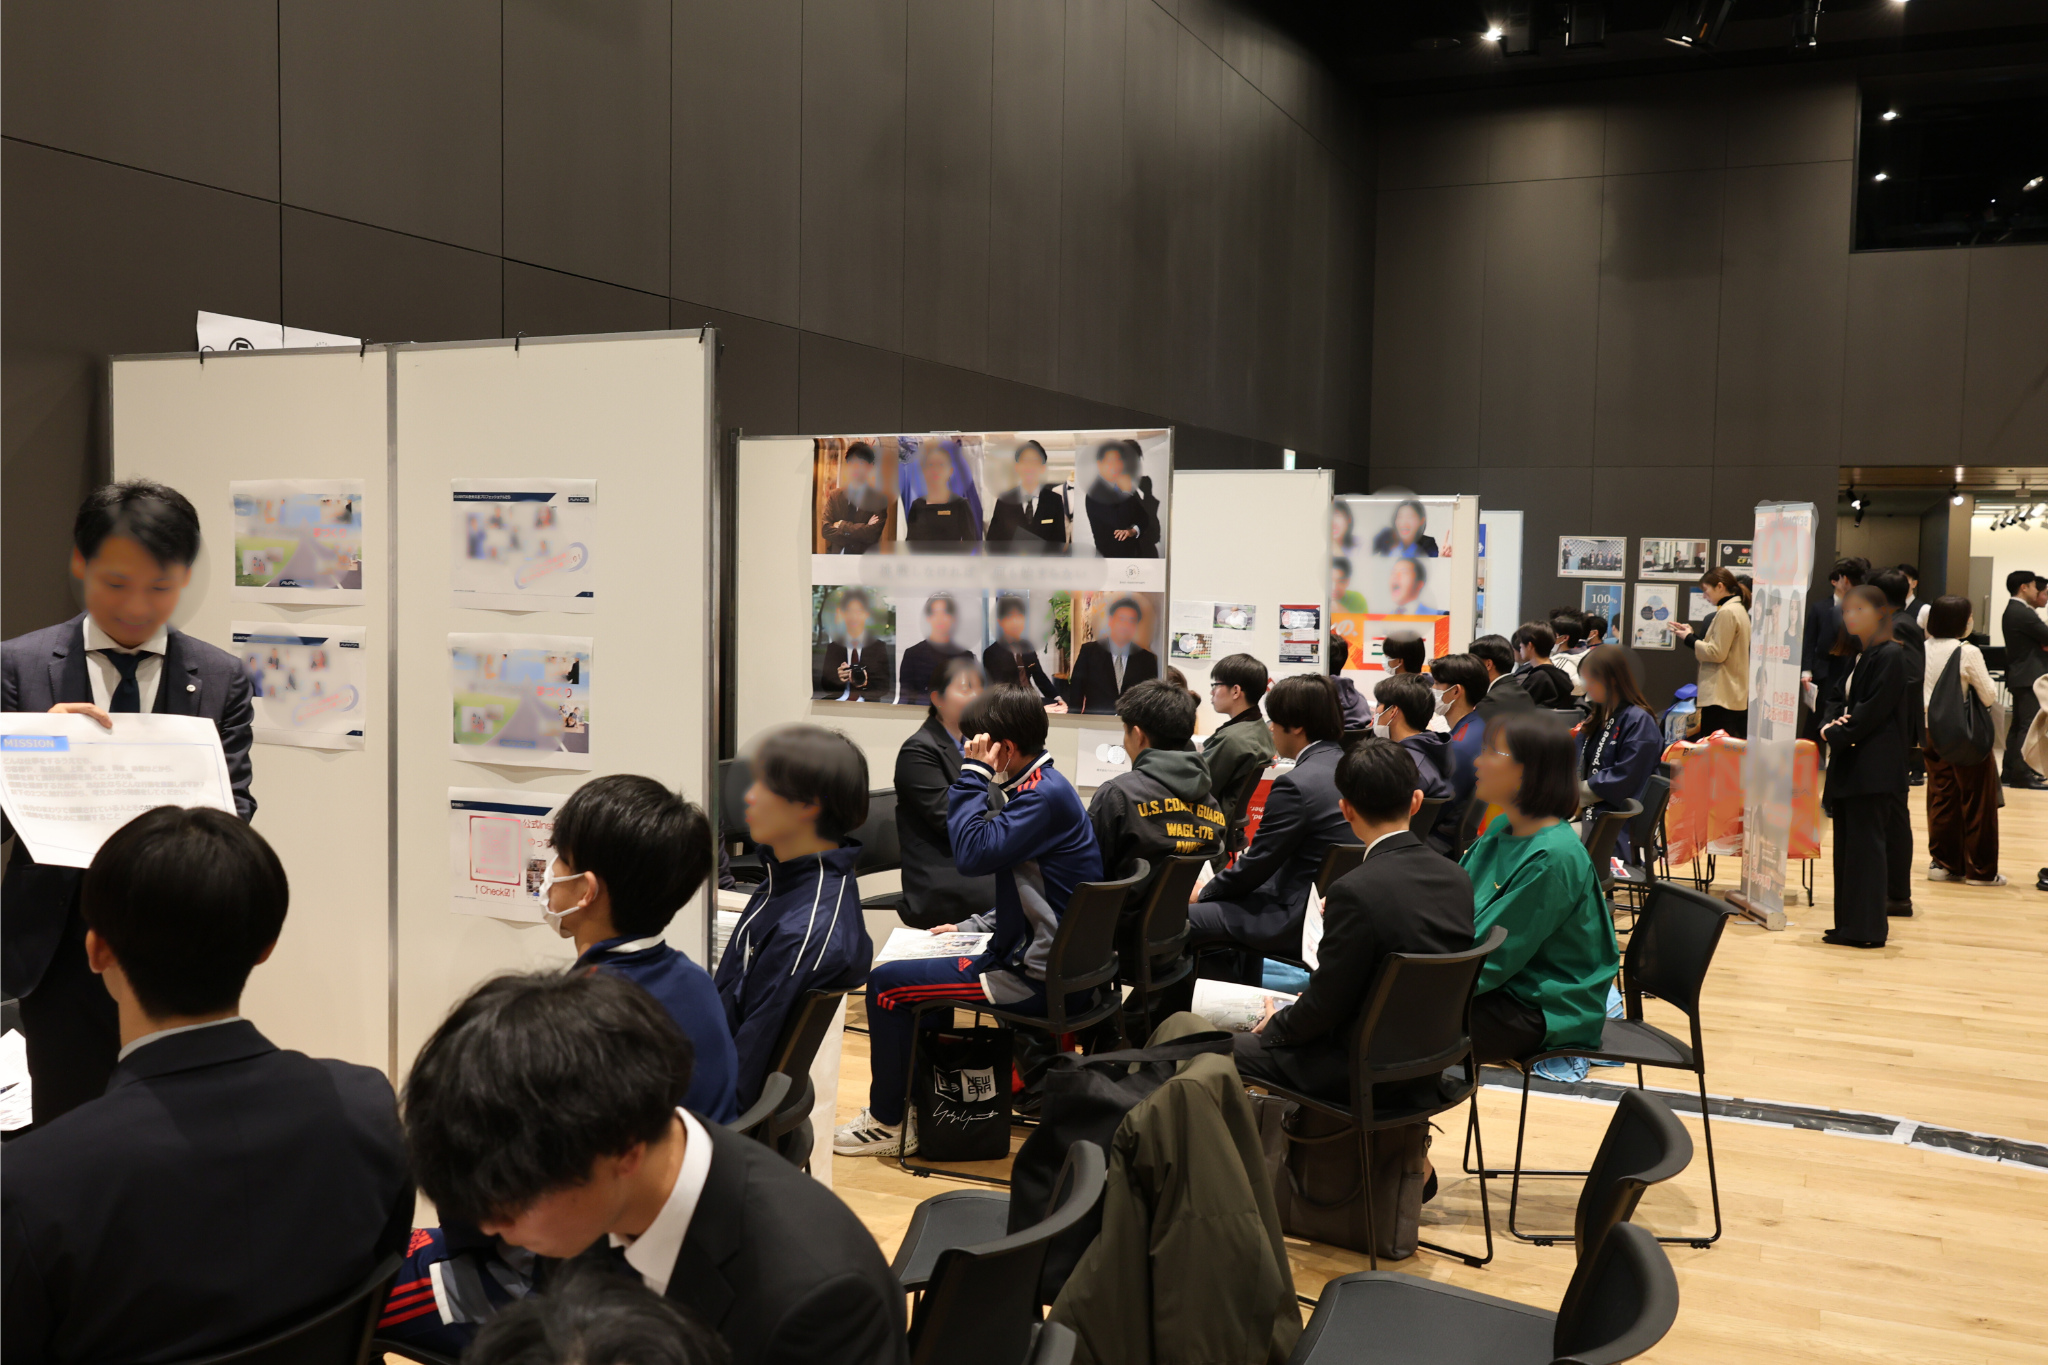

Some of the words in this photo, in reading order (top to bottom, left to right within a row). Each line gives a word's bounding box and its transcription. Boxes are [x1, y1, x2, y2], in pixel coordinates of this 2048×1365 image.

[3, 738, 55, 749] MISSION
[1137, 800, 1163, 817] U.S.
[1164, 797, 1194, 814] COAT
[1197, 804, 1226, 826] GUARD
[1166, 822, 1214, 840] WAGL-176
[967, 1075, 991, 1086] NEW
[968, 1083, 992, 1095] ERA
